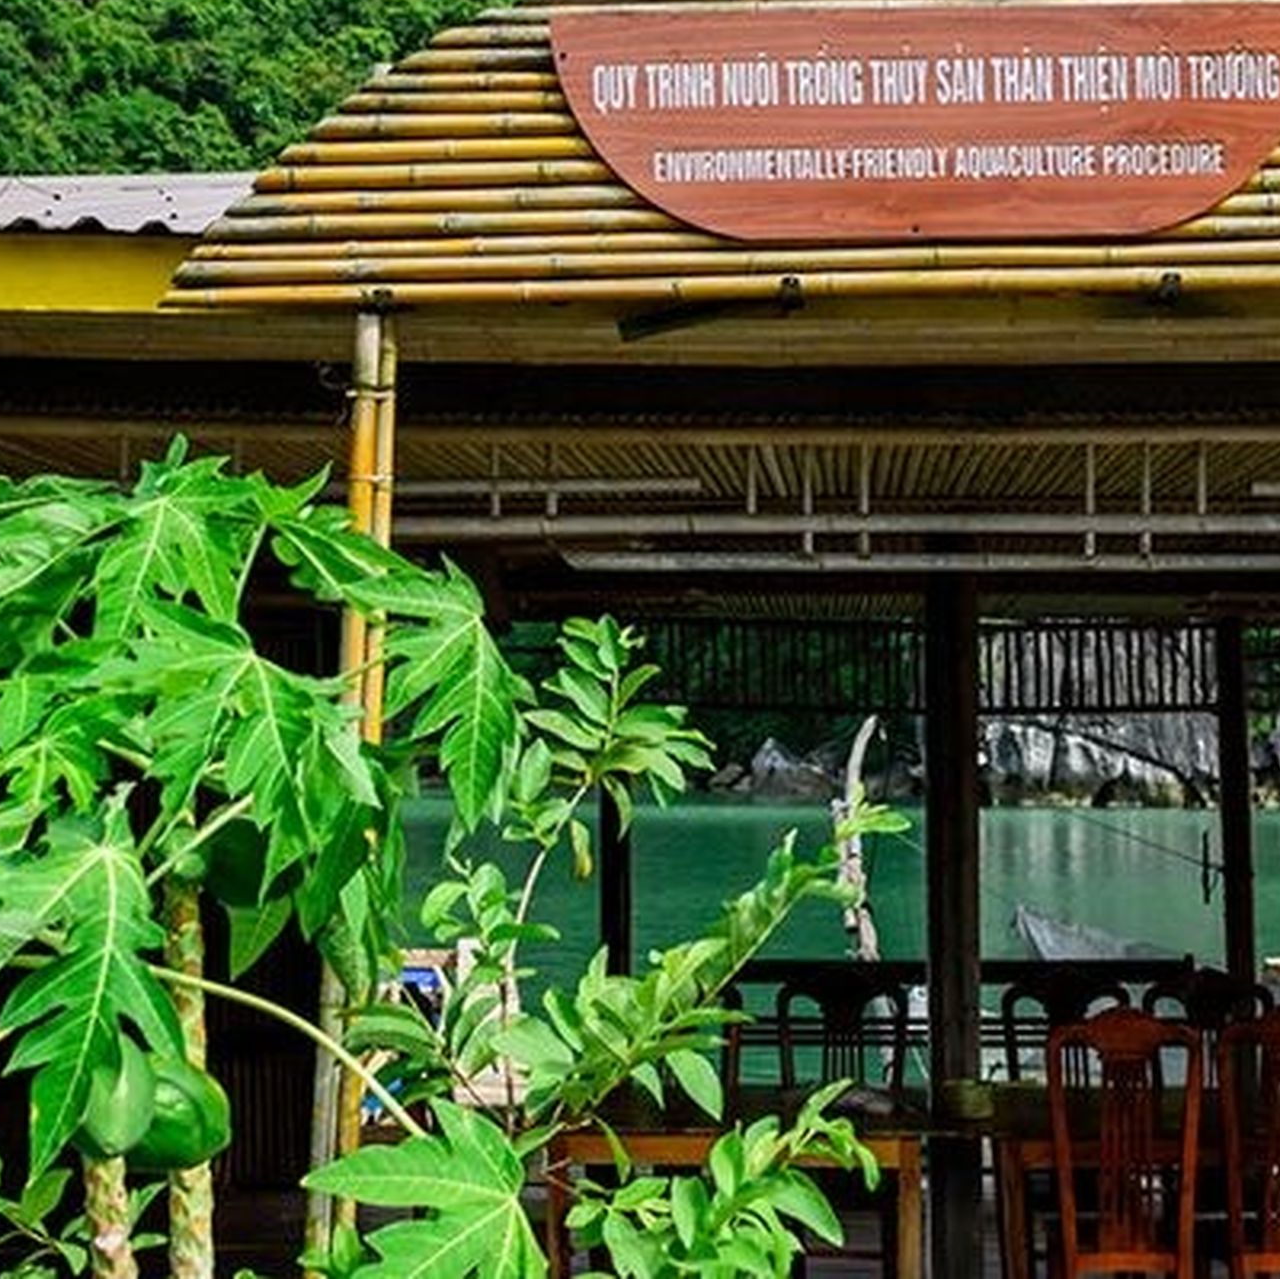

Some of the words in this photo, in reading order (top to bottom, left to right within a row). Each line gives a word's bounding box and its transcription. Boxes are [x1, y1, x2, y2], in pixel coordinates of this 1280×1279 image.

[593, 64, 639, 116] QUY
[722, 52, 780, 106] NUÔI
[654, 147, 947, 182] ENVIRONMENTALLY-FRIENDLY
[954, 143, 1096, 179] AQUACULTURE
[1102, 142, 1225, 176] PROCEDURE
